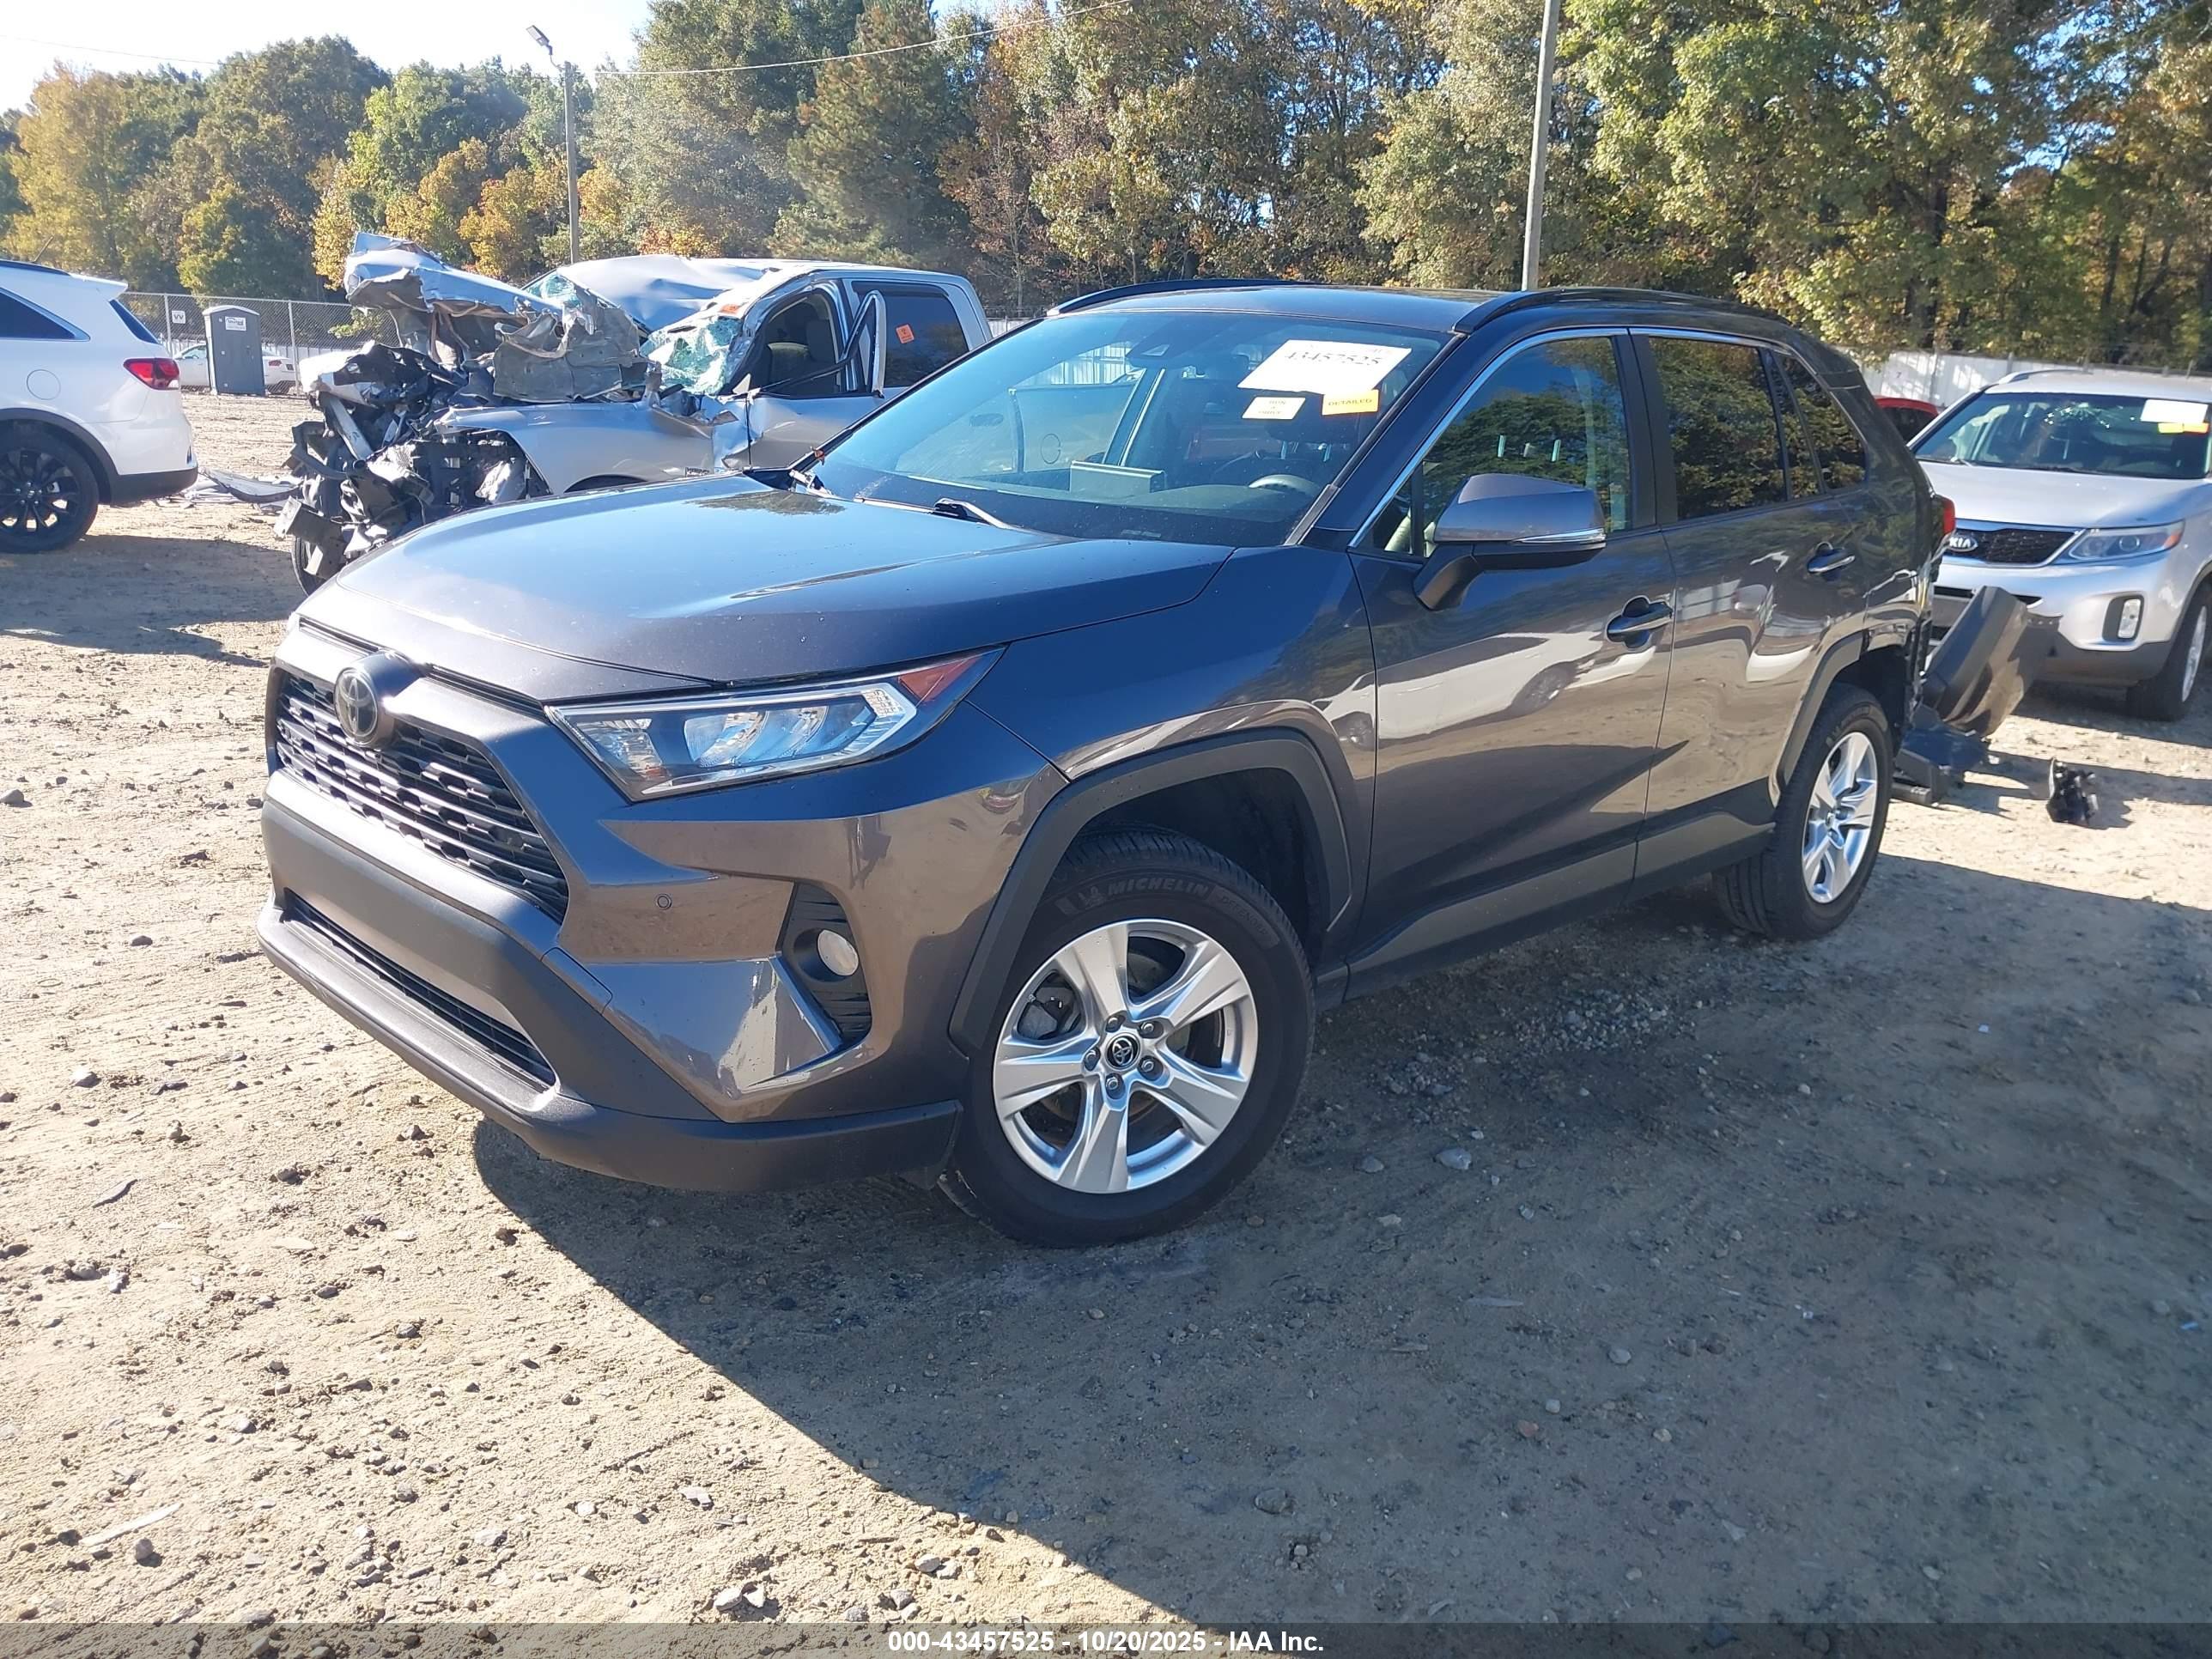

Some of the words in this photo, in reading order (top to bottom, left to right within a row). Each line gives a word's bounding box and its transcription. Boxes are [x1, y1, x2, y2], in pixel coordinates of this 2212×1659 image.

[1328, 398, 1373, 406] DETAILED
[1949, 537, 1971, 548] KIA
[1108, 878, 1209, 897] MICHELIN
